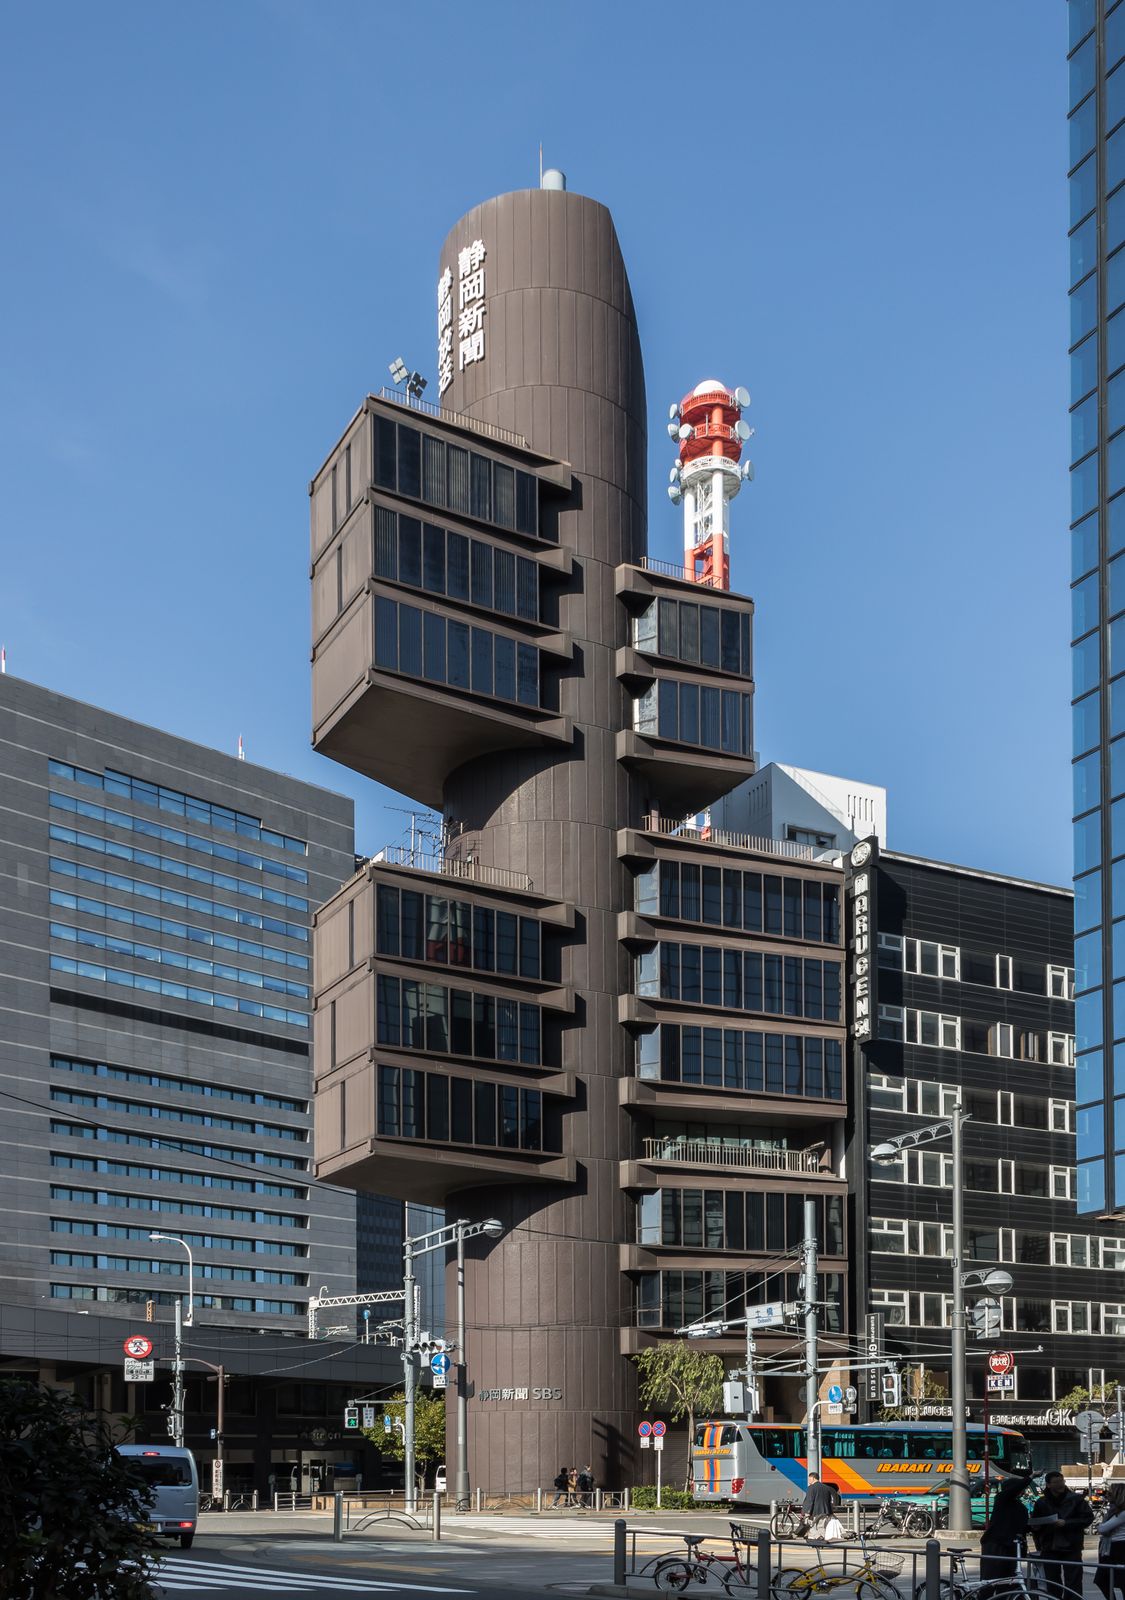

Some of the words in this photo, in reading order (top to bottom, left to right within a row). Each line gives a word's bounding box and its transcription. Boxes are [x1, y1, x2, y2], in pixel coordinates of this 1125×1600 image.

[458, 239, 486, 371] 静岡新聞
[854, 873, 868, 1018] MARUGEN
[990, 1379, 1011, 1387] KEN
[479, 1387, 529, 1401] 静岡新聞
[532, 1387, 562, 1401] SBS
[876, 1463, 933, 1473] IBARAKI
[936, 1463, 982, 1473] KOSU
